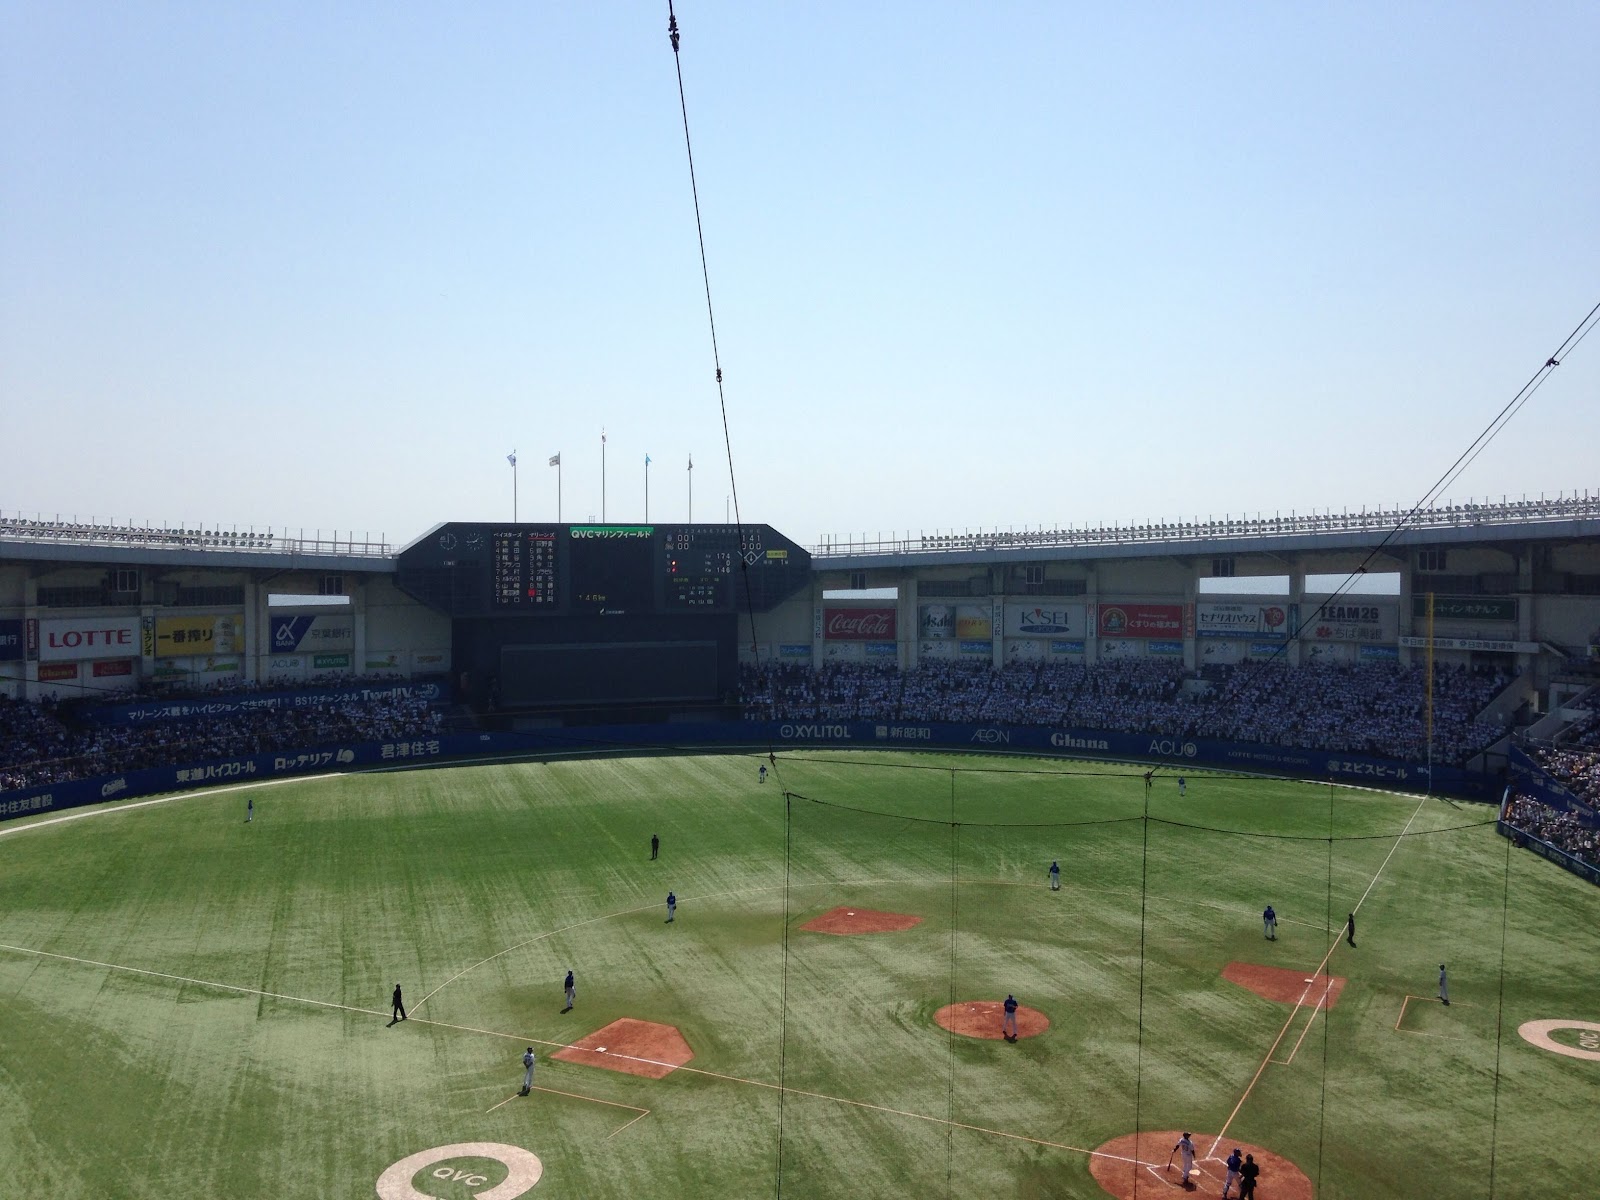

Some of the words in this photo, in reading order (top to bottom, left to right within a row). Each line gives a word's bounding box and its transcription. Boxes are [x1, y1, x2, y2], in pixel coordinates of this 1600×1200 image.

[572, 530, 650, 538] QVCマリンフィールド
[922, 614, 953, 627] Asahi
[49, 630, 131, 648] LOTTE
[158, 630, 213, 643] 一番搾り
[795, 725, 851, 738] XYLITOL
[890, 727, 930, 739] 新昭和
[381, 740, 440, 758] 君津住宅
[1050, 733, 1109, 750] Ghana
[275, 752, 333, 770] ロッテリア
[176, 760, 256, 783] 東進ハイスクール
[432, 1167, 487, 1186] QVC
